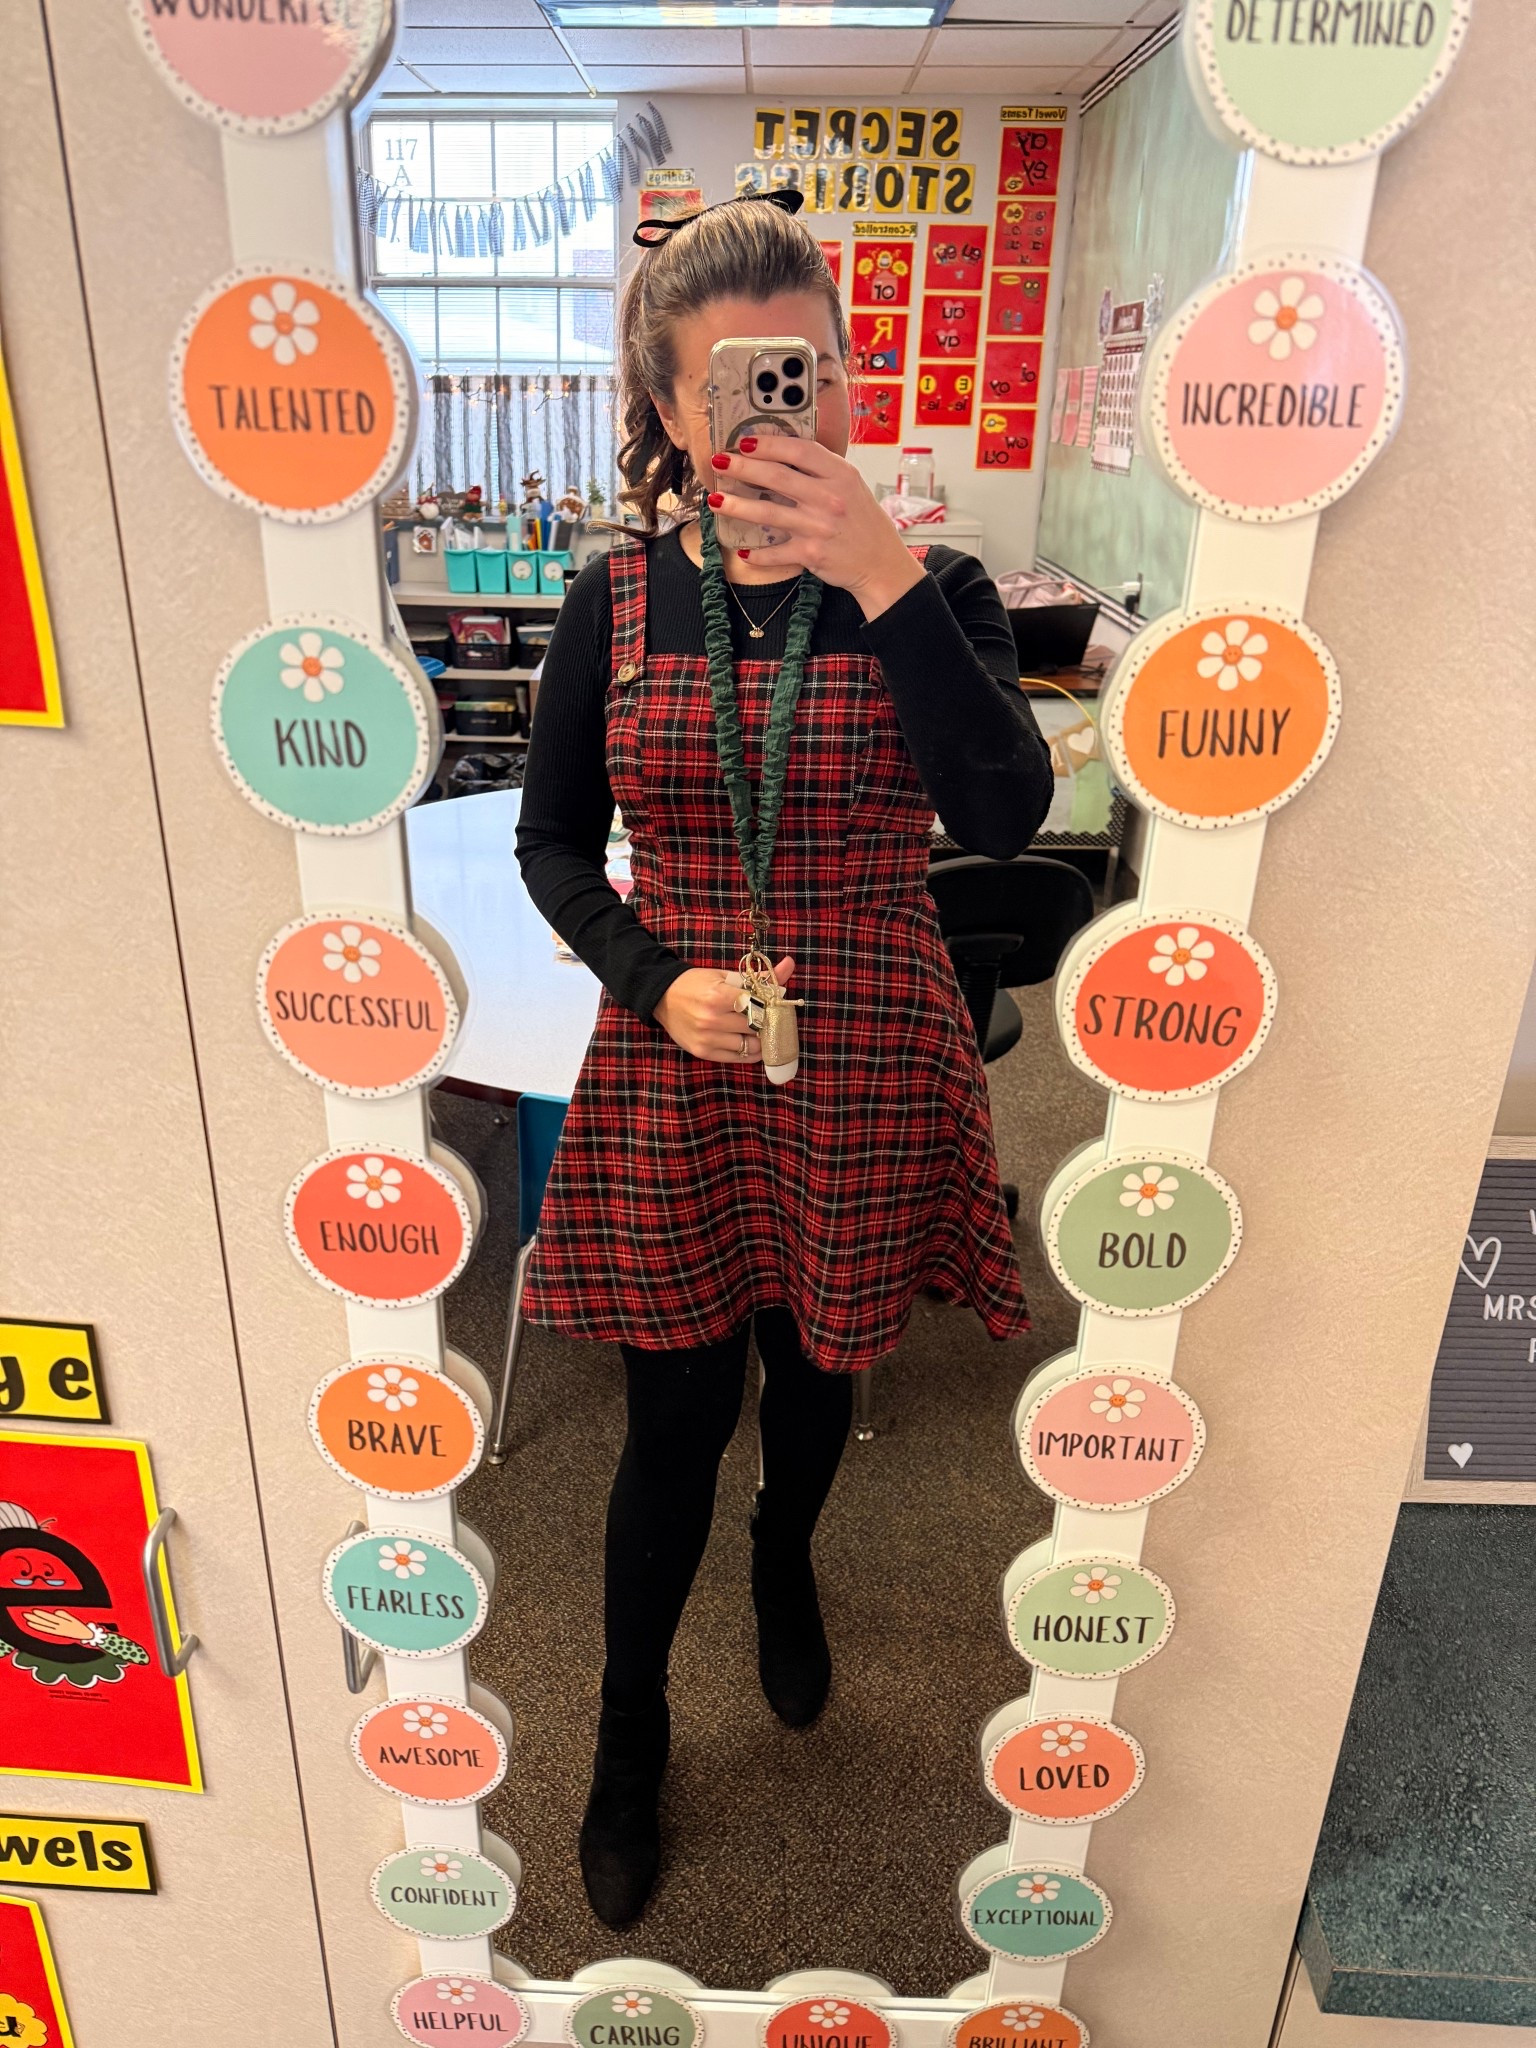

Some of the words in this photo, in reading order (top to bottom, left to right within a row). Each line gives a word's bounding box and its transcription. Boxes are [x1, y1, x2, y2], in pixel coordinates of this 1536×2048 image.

[1226, 0, 1435, 47] DETERMINED
[385, 138, 418, 161] 117
[393, 165, 413, 187] A
[211, 385, 376, 435] TALENTED
[1182, 383, 1366, 428] INCREDIBLE
[274, 718, 367, 769] KIND
[1157, 708, 1291, 759] FUNNY
[275, 990, 437, 1031] SUCCESSFUL
[1083, 994, 1242, 1047] STRONG
[319, 1220, 440, 1256] ENOUGH
[1098, 1232, 1187, 1269] BOLD
[49, 1357, 92, 1401] e
[348, 1419, 446, 1457] BRAVE
[1038, 1431, 1185, 1463] IMPORTANT
[347, 1585, 465, 1620] FEARLESS
[1033, 1614, 1154, 1644] HONEST
[379, 1746, 484, 1768] AWESOME
[1019, 1764, 1110, 1791] LOVED
[390, 1886, 500, 1908] CONFIDENT
[974, 1909, 1098, 1926] EXCEPTIONAL
[413, 2011, 507, 2032] HELPFUL
[589, 2025, 680, 2047] CARING
